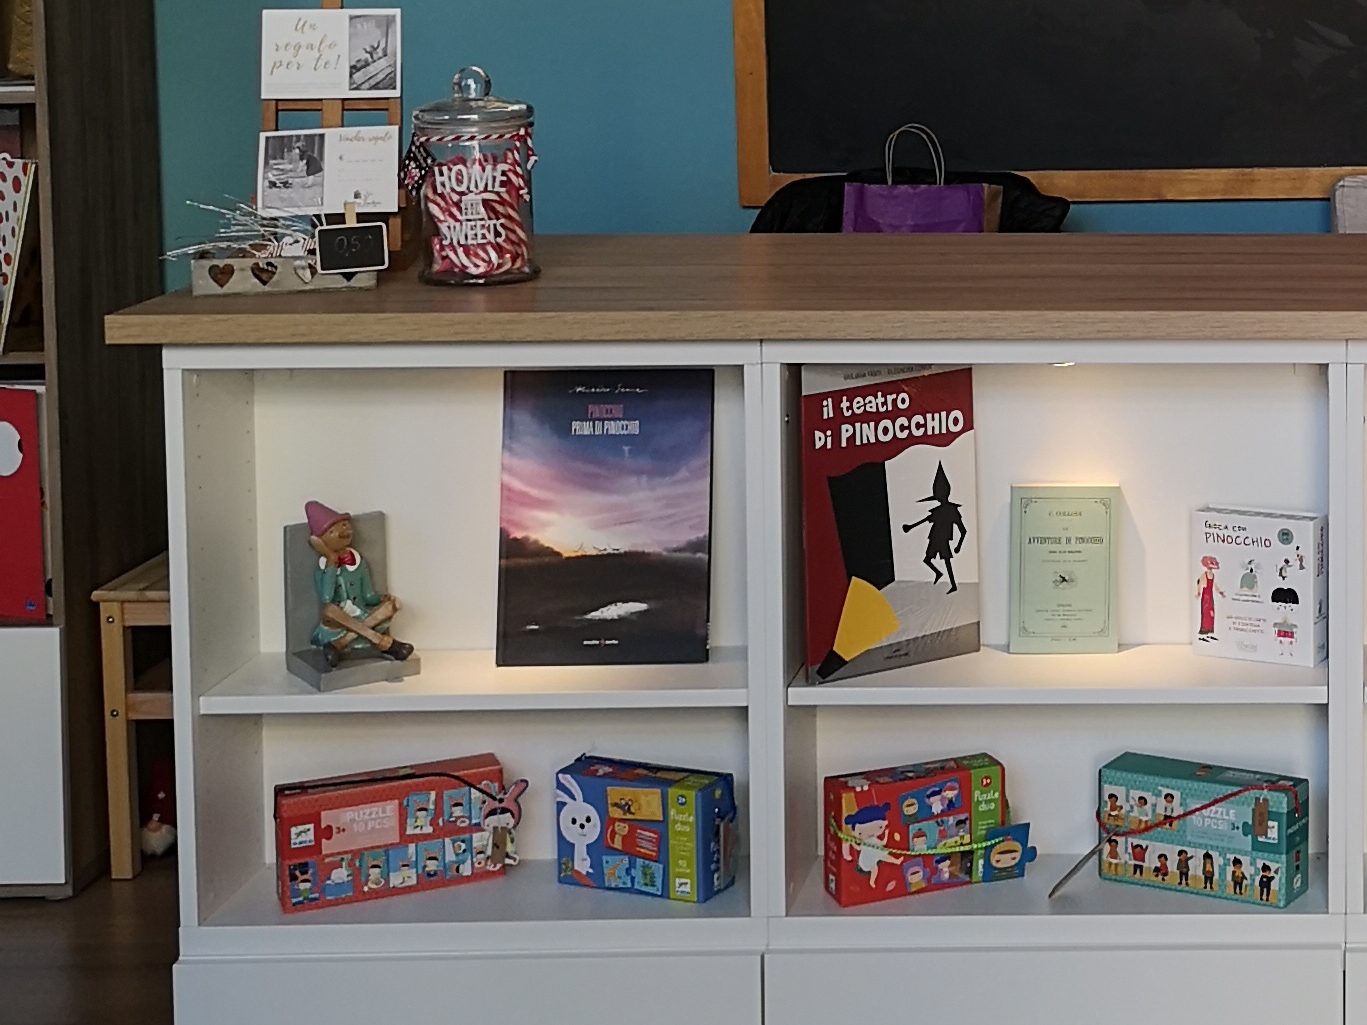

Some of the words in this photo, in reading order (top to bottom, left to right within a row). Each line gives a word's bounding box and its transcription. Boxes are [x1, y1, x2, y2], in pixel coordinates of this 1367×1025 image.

[294, 17, 317, 34] Un
[275, 34, 338, 57] regalo
[270, 58, 303, 76] per
[434, 164, 508, 193] HOME
[441, 218, 506, 245] SWEETS
[822, 397, 833, 419] il
[841, 391, 910, 418] teatro
[572, 421, 594, 435] PRIMA
[595, 421, 603, 435] DI
[604, 420, 639, 435] PINOCCHIO
[841, 409, 965, 448] PINOCCHIO
[1027, 536, 1062, 544] AVVENTURE
[1205, 531, 1272, 548] PINOCCHIO
[974, 789, 999, 802] Puzzle
[347, 805, 394, 823] PUZZLE
[979, 801, 995, 811] duo
[1196, 806, 1237, 821] UZZLE
[353, 822, 364, 832] 10
[368, 816, 390, 831] PCS
[1193, 816, 1203, 826] 10
[1205, 817, 1225, 829] PCS
